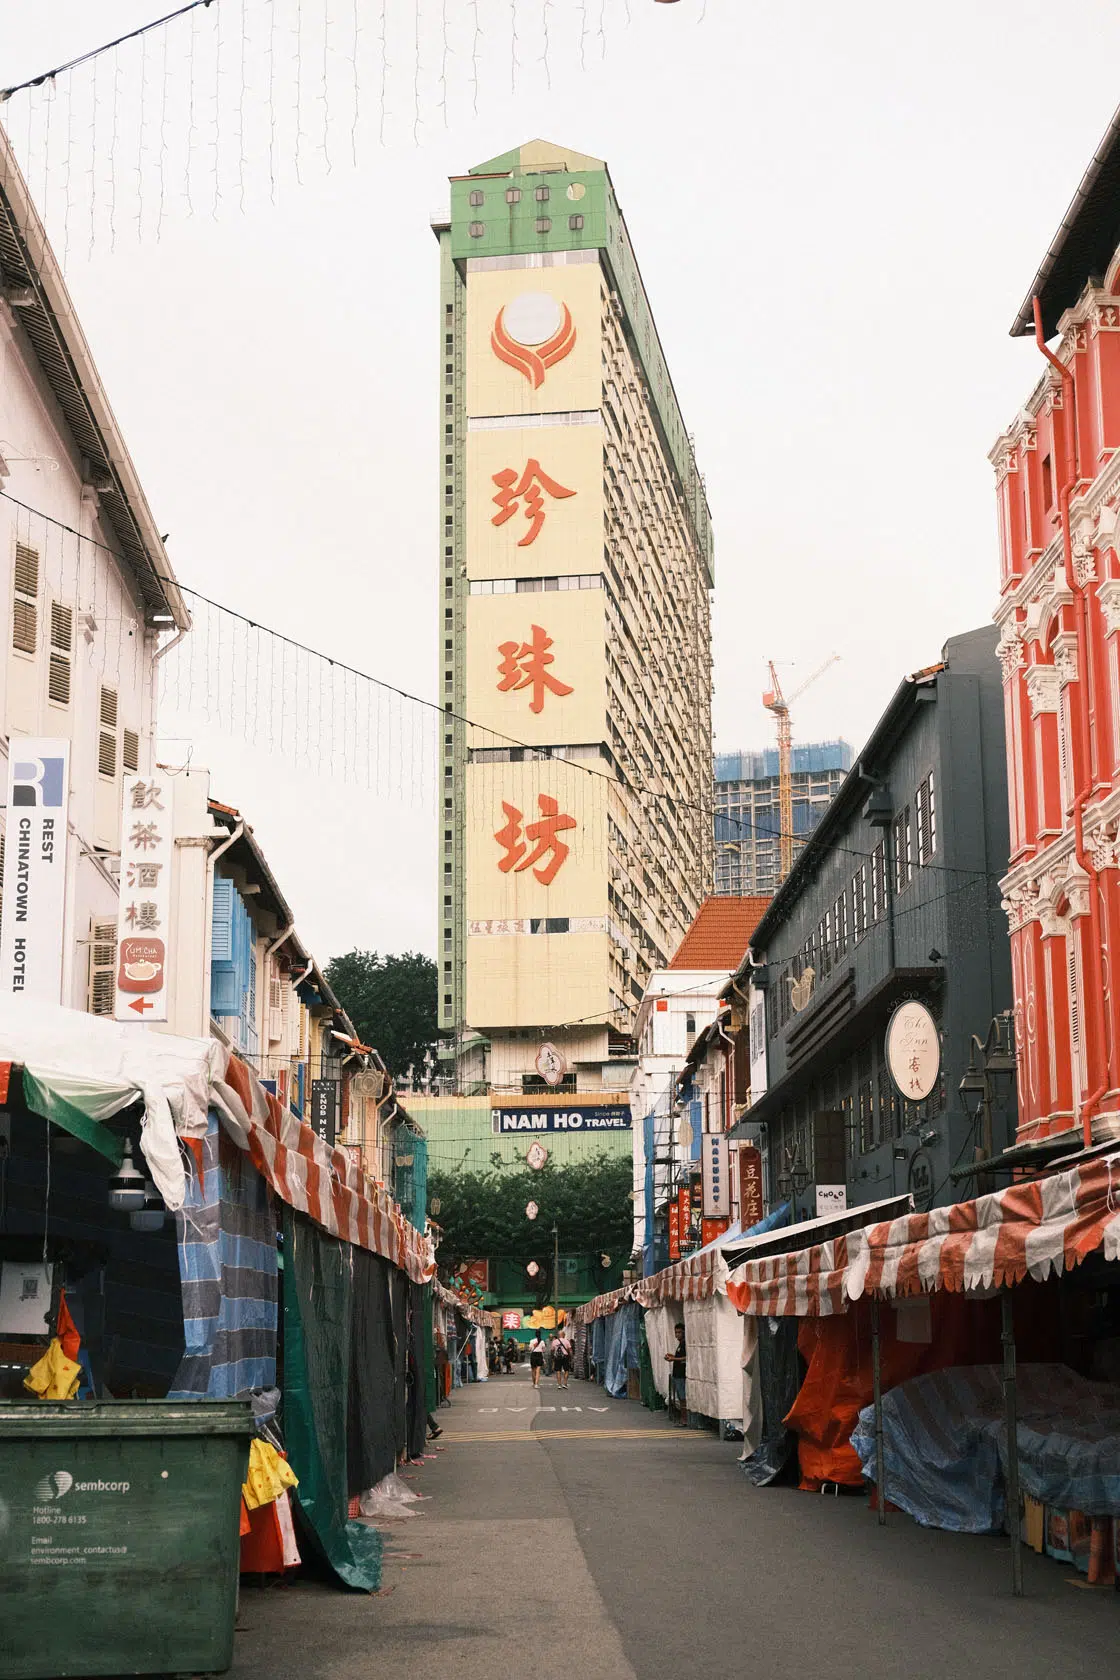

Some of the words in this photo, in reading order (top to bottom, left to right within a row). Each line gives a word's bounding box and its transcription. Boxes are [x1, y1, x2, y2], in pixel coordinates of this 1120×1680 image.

[490, 457, 578, 887] 珍珠坊
[41, 818, 55, 864] REST
[126, 779, 165, 931] 飲茶酒樓
[15, 817, 32, 922] CHINATOWN
[126, 942, 142, 961] YUM
[143, 946, 158, 955] CHA
[319, 1093, 328, 1116] KNOB
[503, 1114, 548, 1130] NAM
[553, 1112, 584, 1129] HO
[585, 1119, 627, 1128] TRAVEL
[743, 1164, 761, 1217] 豆花庄
[75, 1479, 130, 1494] sembcorp
[33, 1506, 62, 1515] Hotline
[33, 1515, 67, 1525] 1800-278
[68, 1515, 87, 1524] 6135
[31, 1536, 53, 1545] Email
